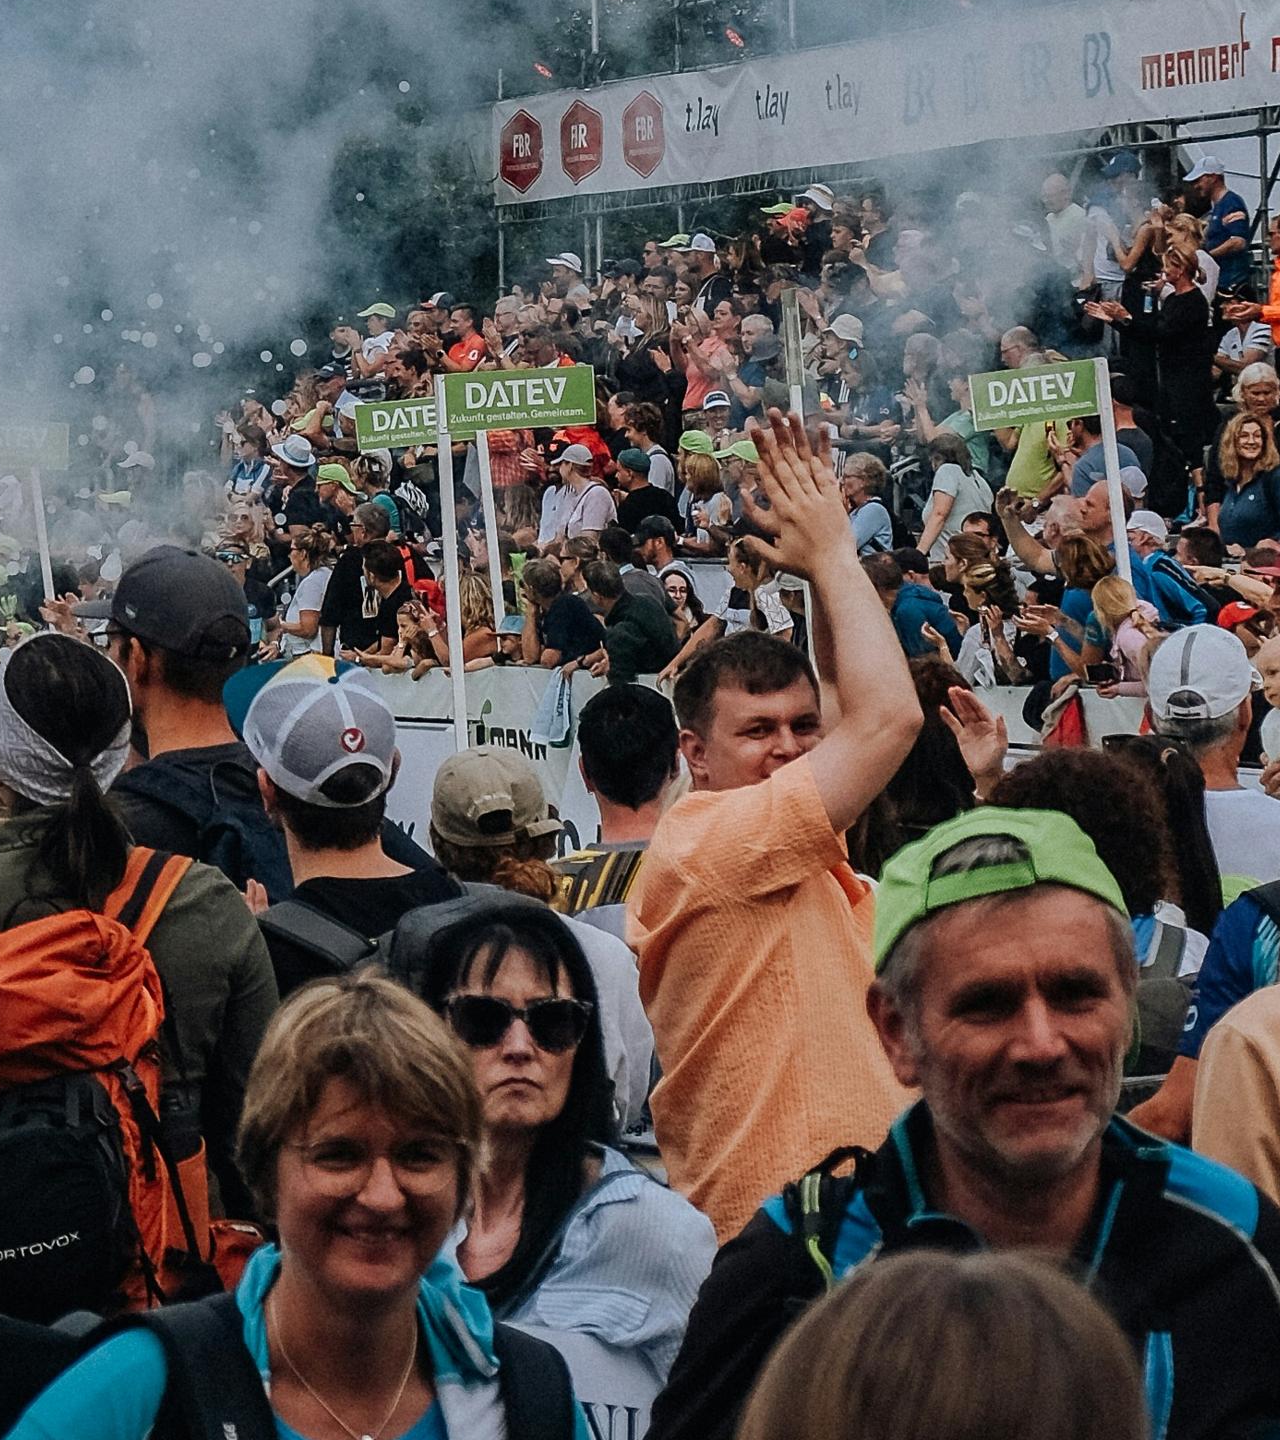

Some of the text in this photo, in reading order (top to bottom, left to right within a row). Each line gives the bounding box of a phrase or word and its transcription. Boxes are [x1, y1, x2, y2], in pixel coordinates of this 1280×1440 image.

[1141, 11, 1251, 90] memmert
[755, 83, 790, 126] t.lay
[825, 72, 863, 116] t.lay
[635, 115, 655, 142] FBR
[685, 96, 721, 137] t.lay
[512, 132, 532, 159] FBR
[464, 376, 567, 410] DATEV
[987, 371, 1076, 407] DATEV
[371, 404, 437, 432] DATE
[450, 412, 486, 424] Zukunft
